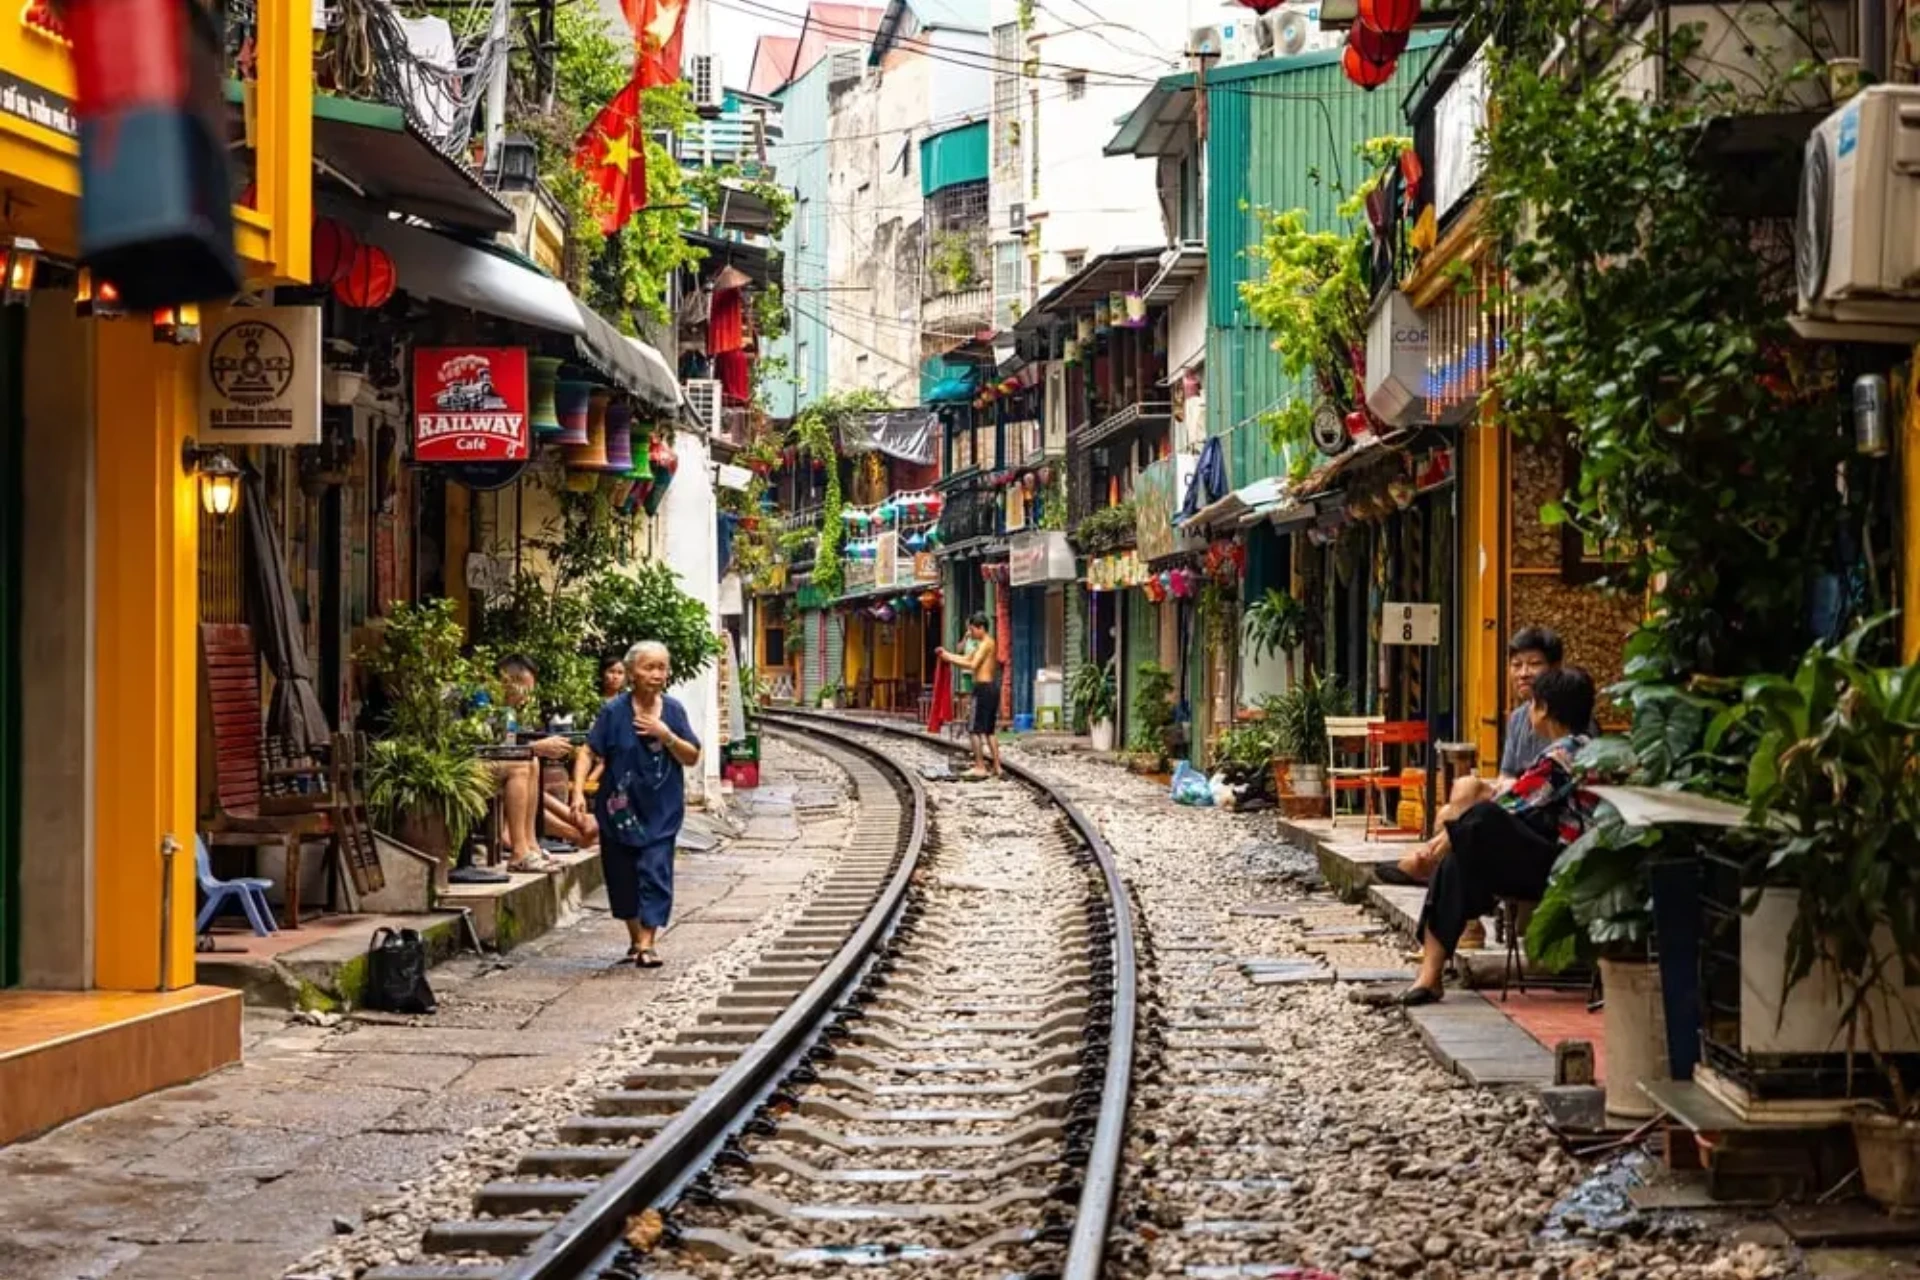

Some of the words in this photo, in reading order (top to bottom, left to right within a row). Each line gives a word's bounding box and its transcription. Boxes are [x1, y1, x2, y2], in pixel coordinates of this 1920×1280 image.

[419, 412, 522, 439] RAILWAY
[456, 437, 487, 450] Café
[1403, 623, 1412, 641] 8
